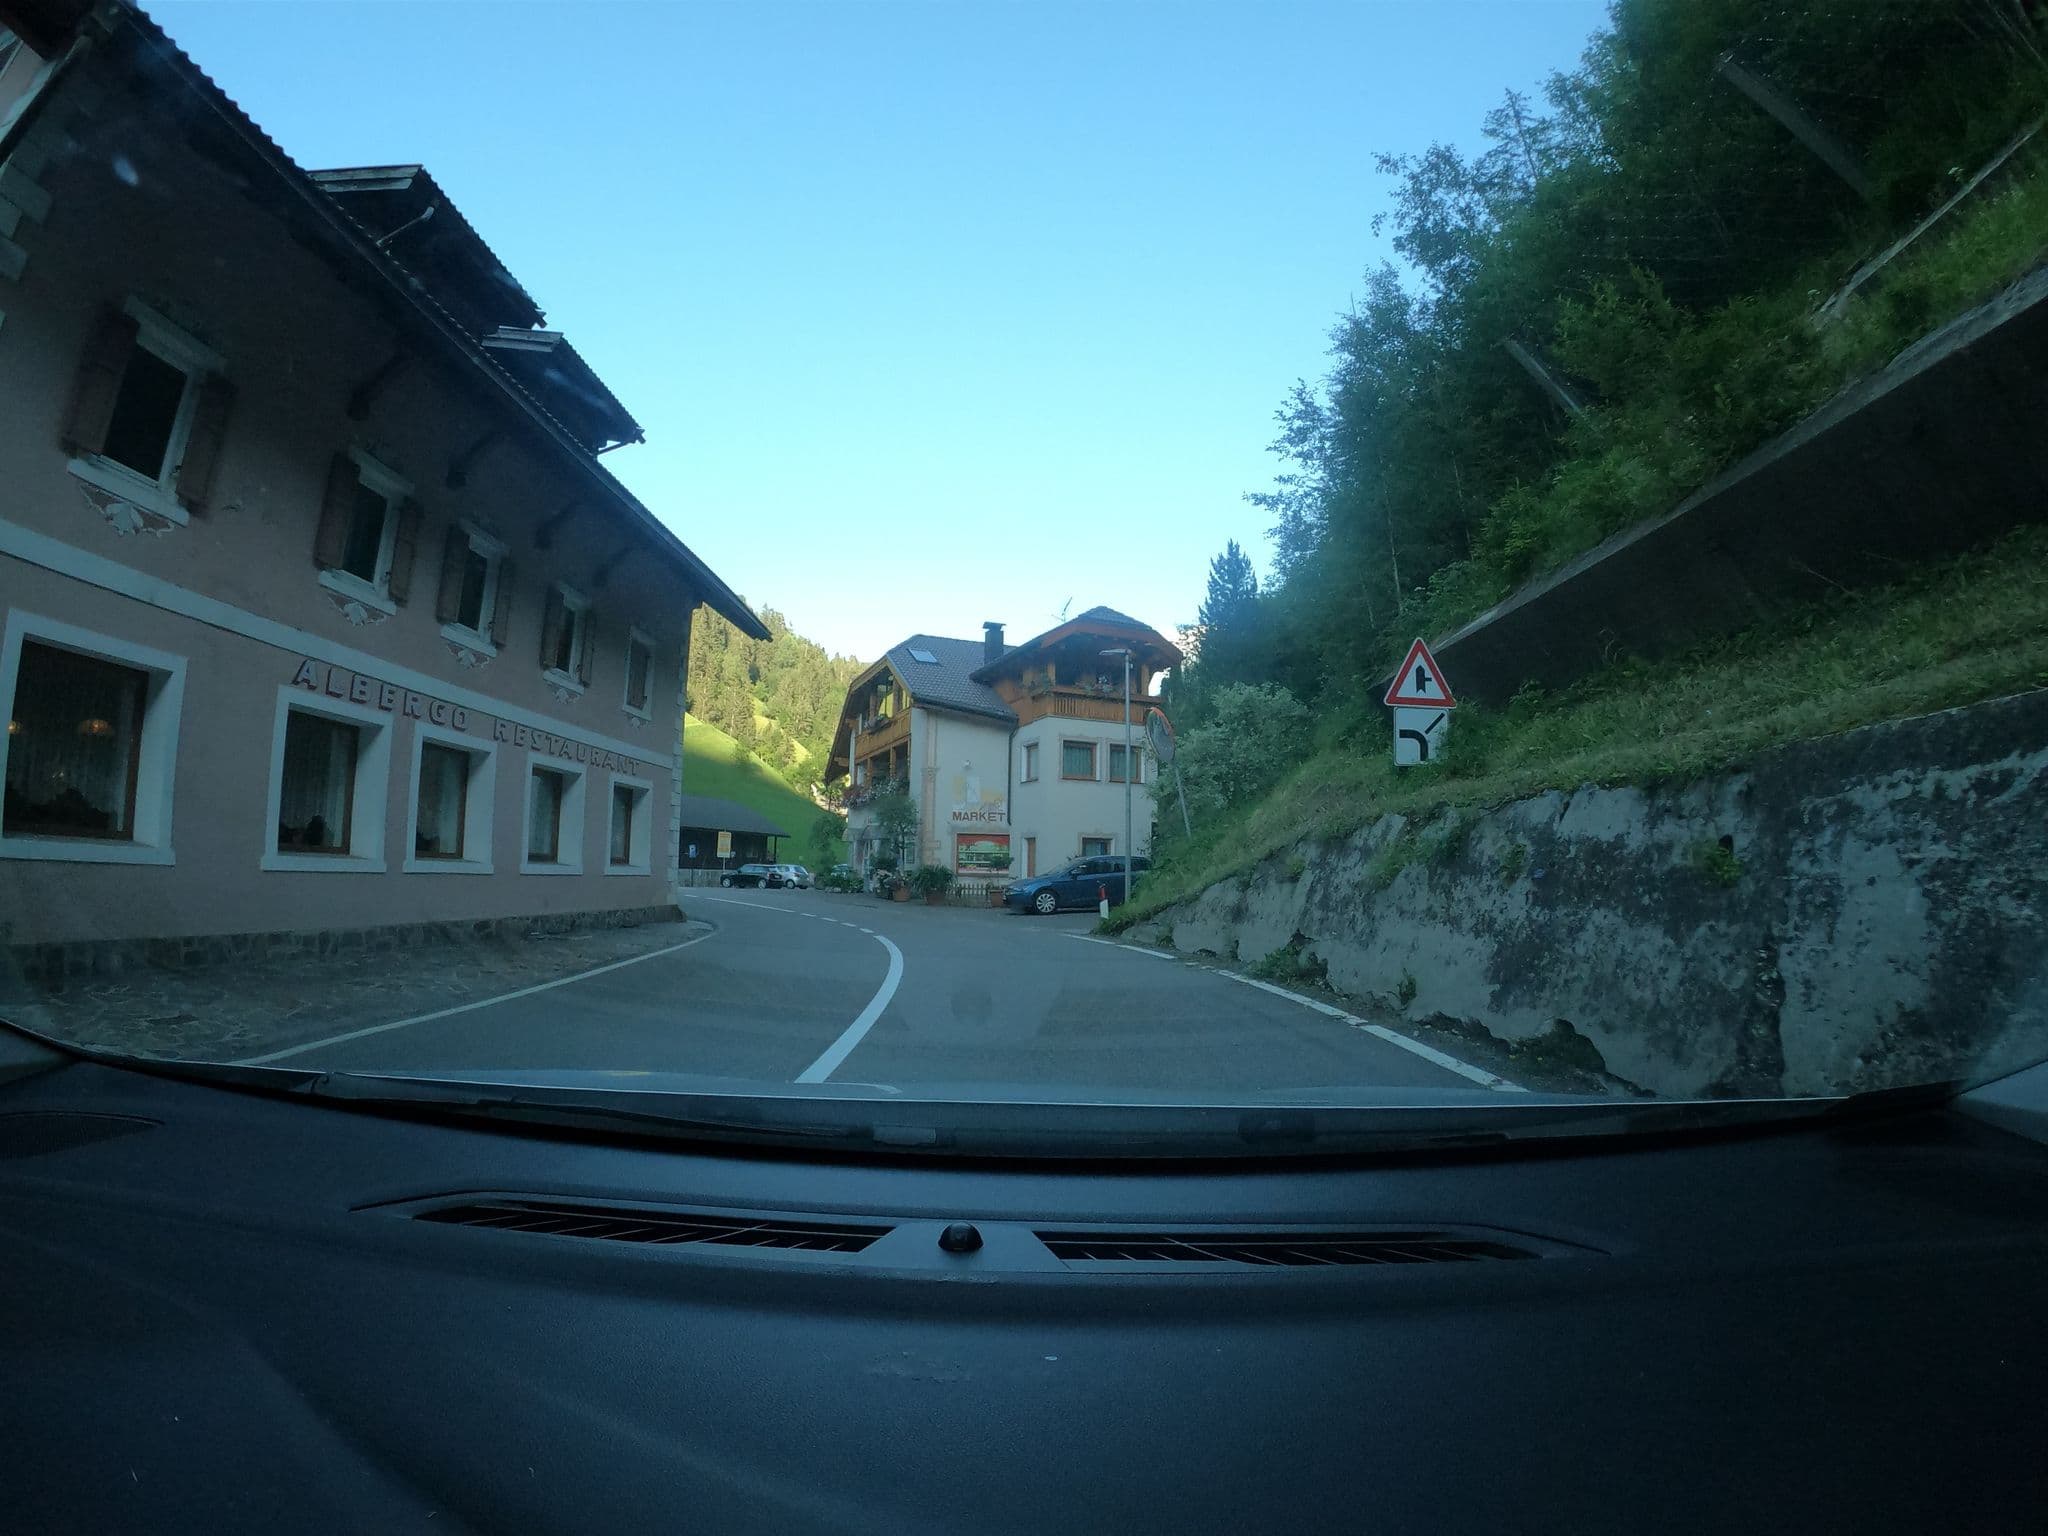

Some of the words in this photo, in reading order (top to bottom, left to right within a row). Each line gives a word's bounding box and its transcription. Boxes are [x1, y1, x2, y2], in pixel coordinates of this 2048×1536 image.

[291, 658, 467, 730] ALBERGO
[493, 719, 640, 776] RESTAURANT
[952, 811, 1006, 822] MARKET
